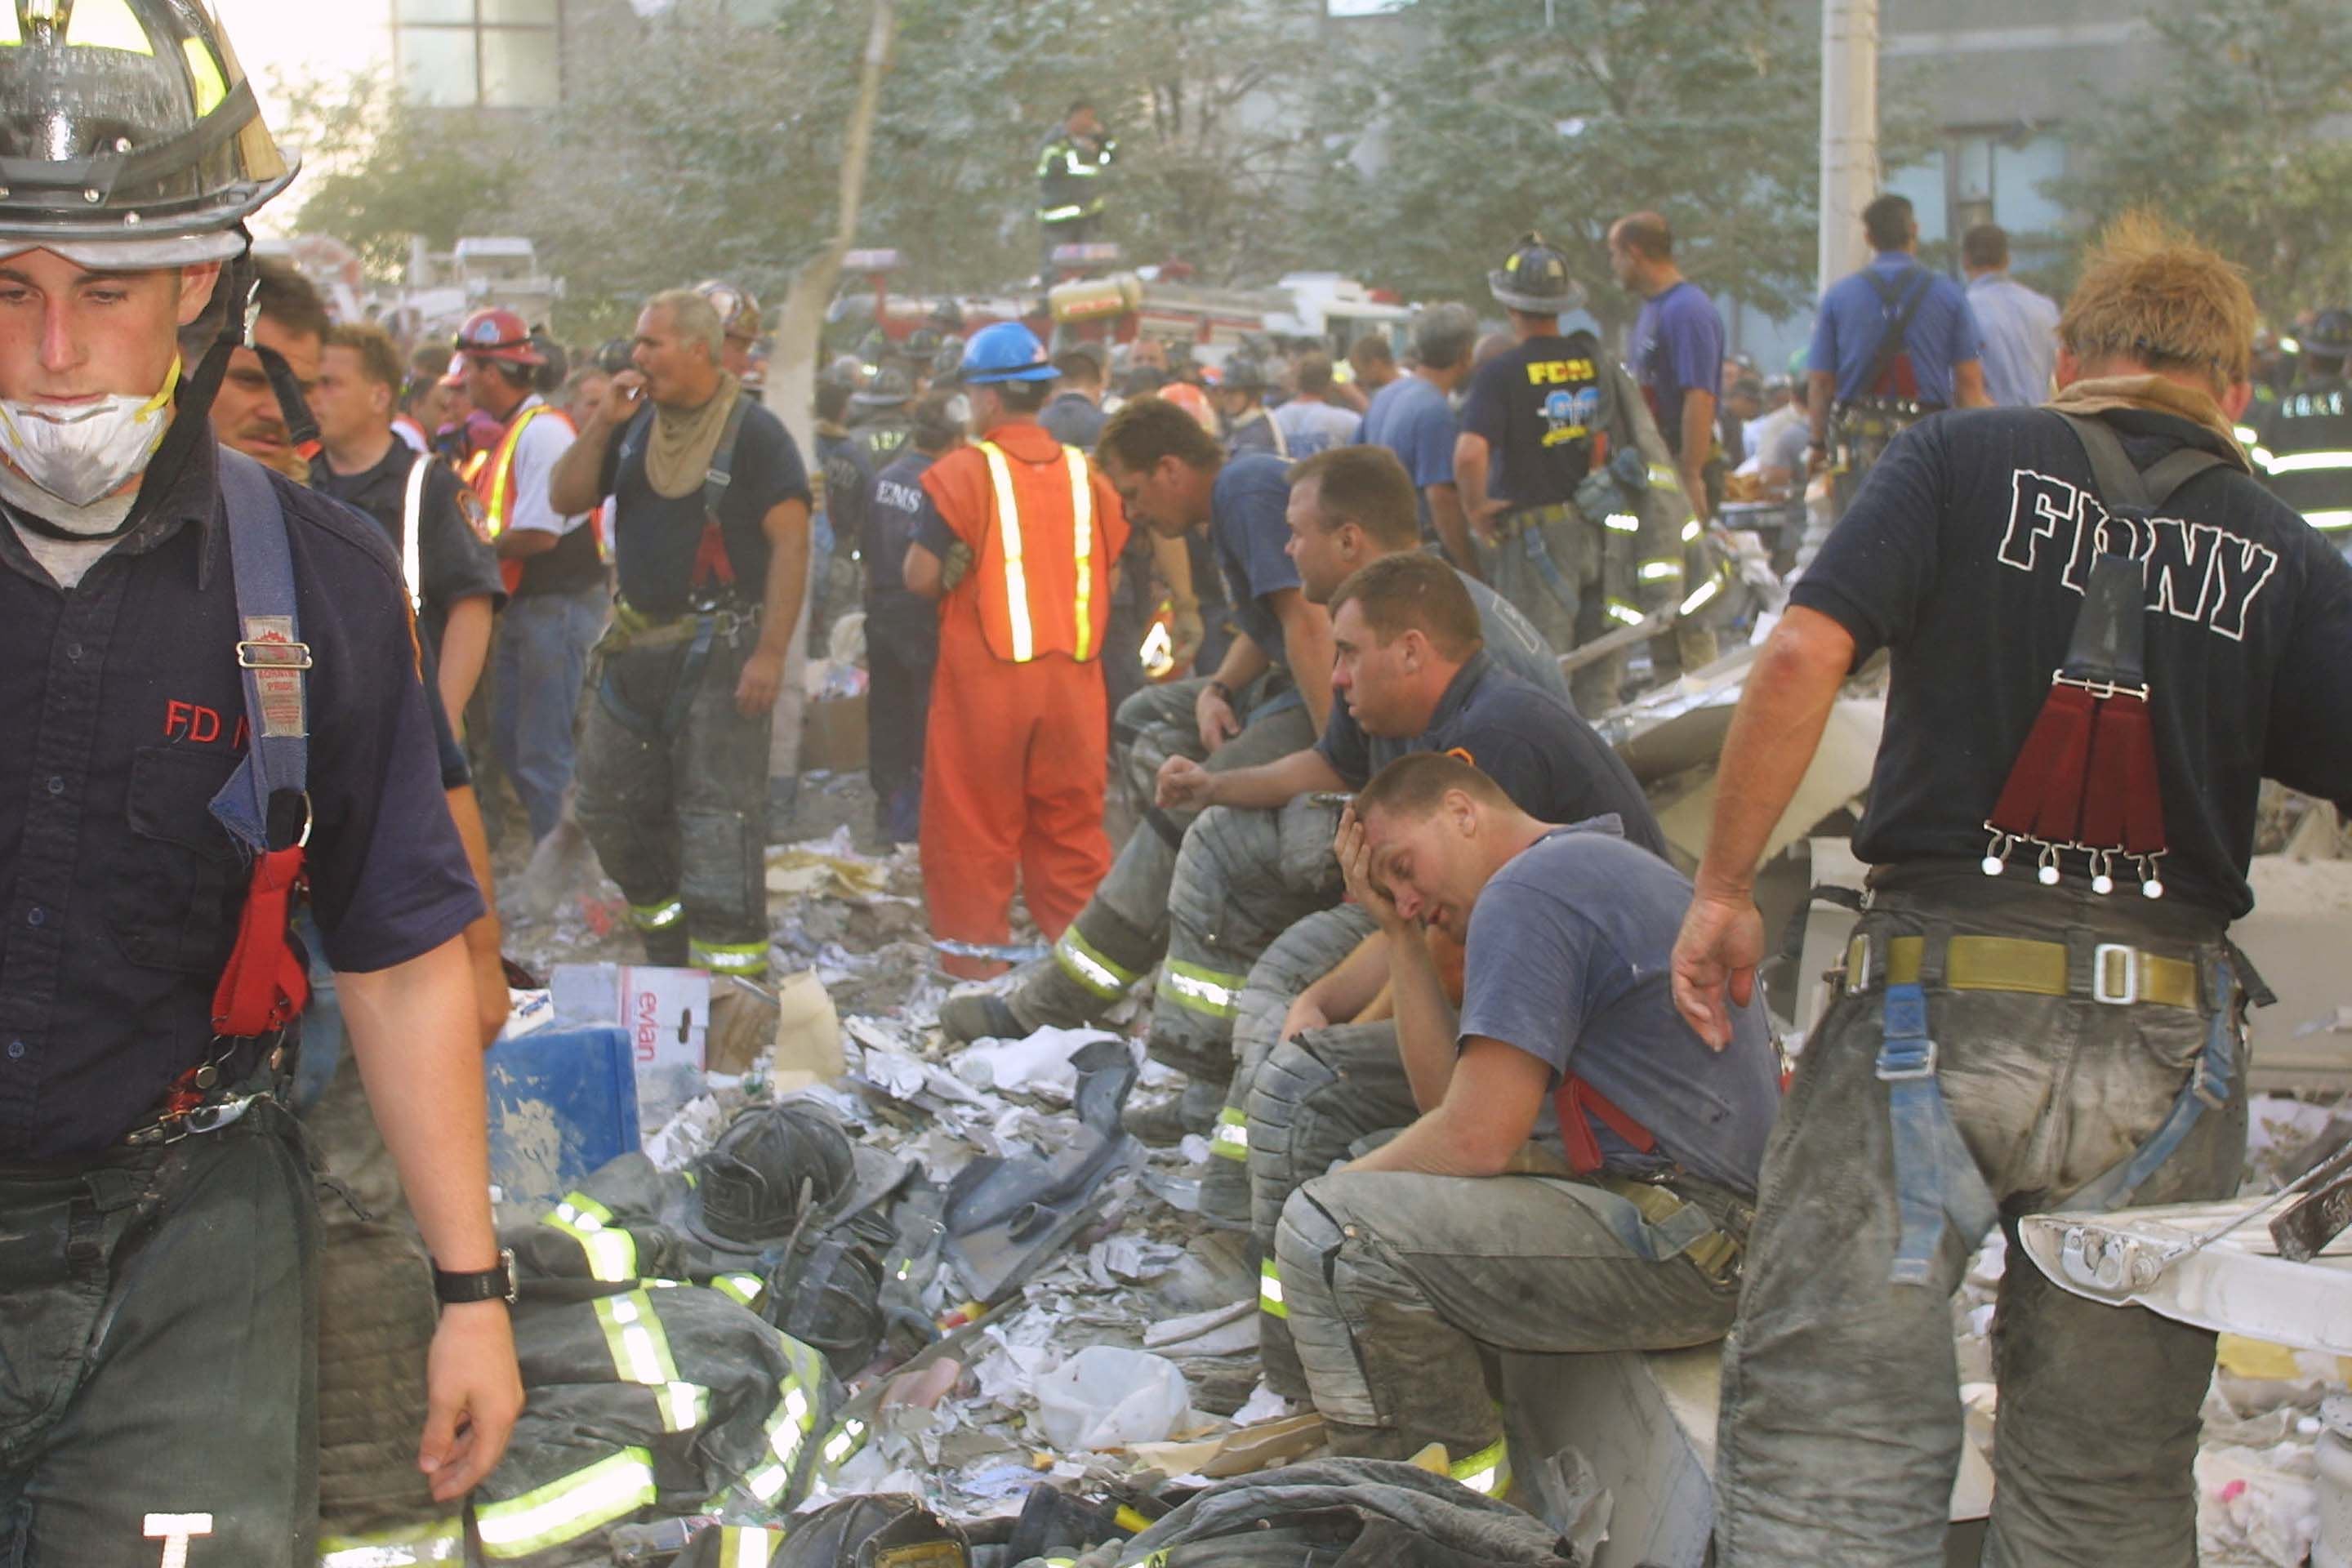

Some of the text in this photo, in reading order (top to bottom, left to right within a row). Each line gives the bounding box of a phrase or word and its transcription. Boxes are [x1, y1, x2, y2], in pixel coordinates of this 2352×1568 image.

[875, 480, 922, 513] EMS
[166, 699, 220, 743] FD
[638, 991, 659, 1062] evian
